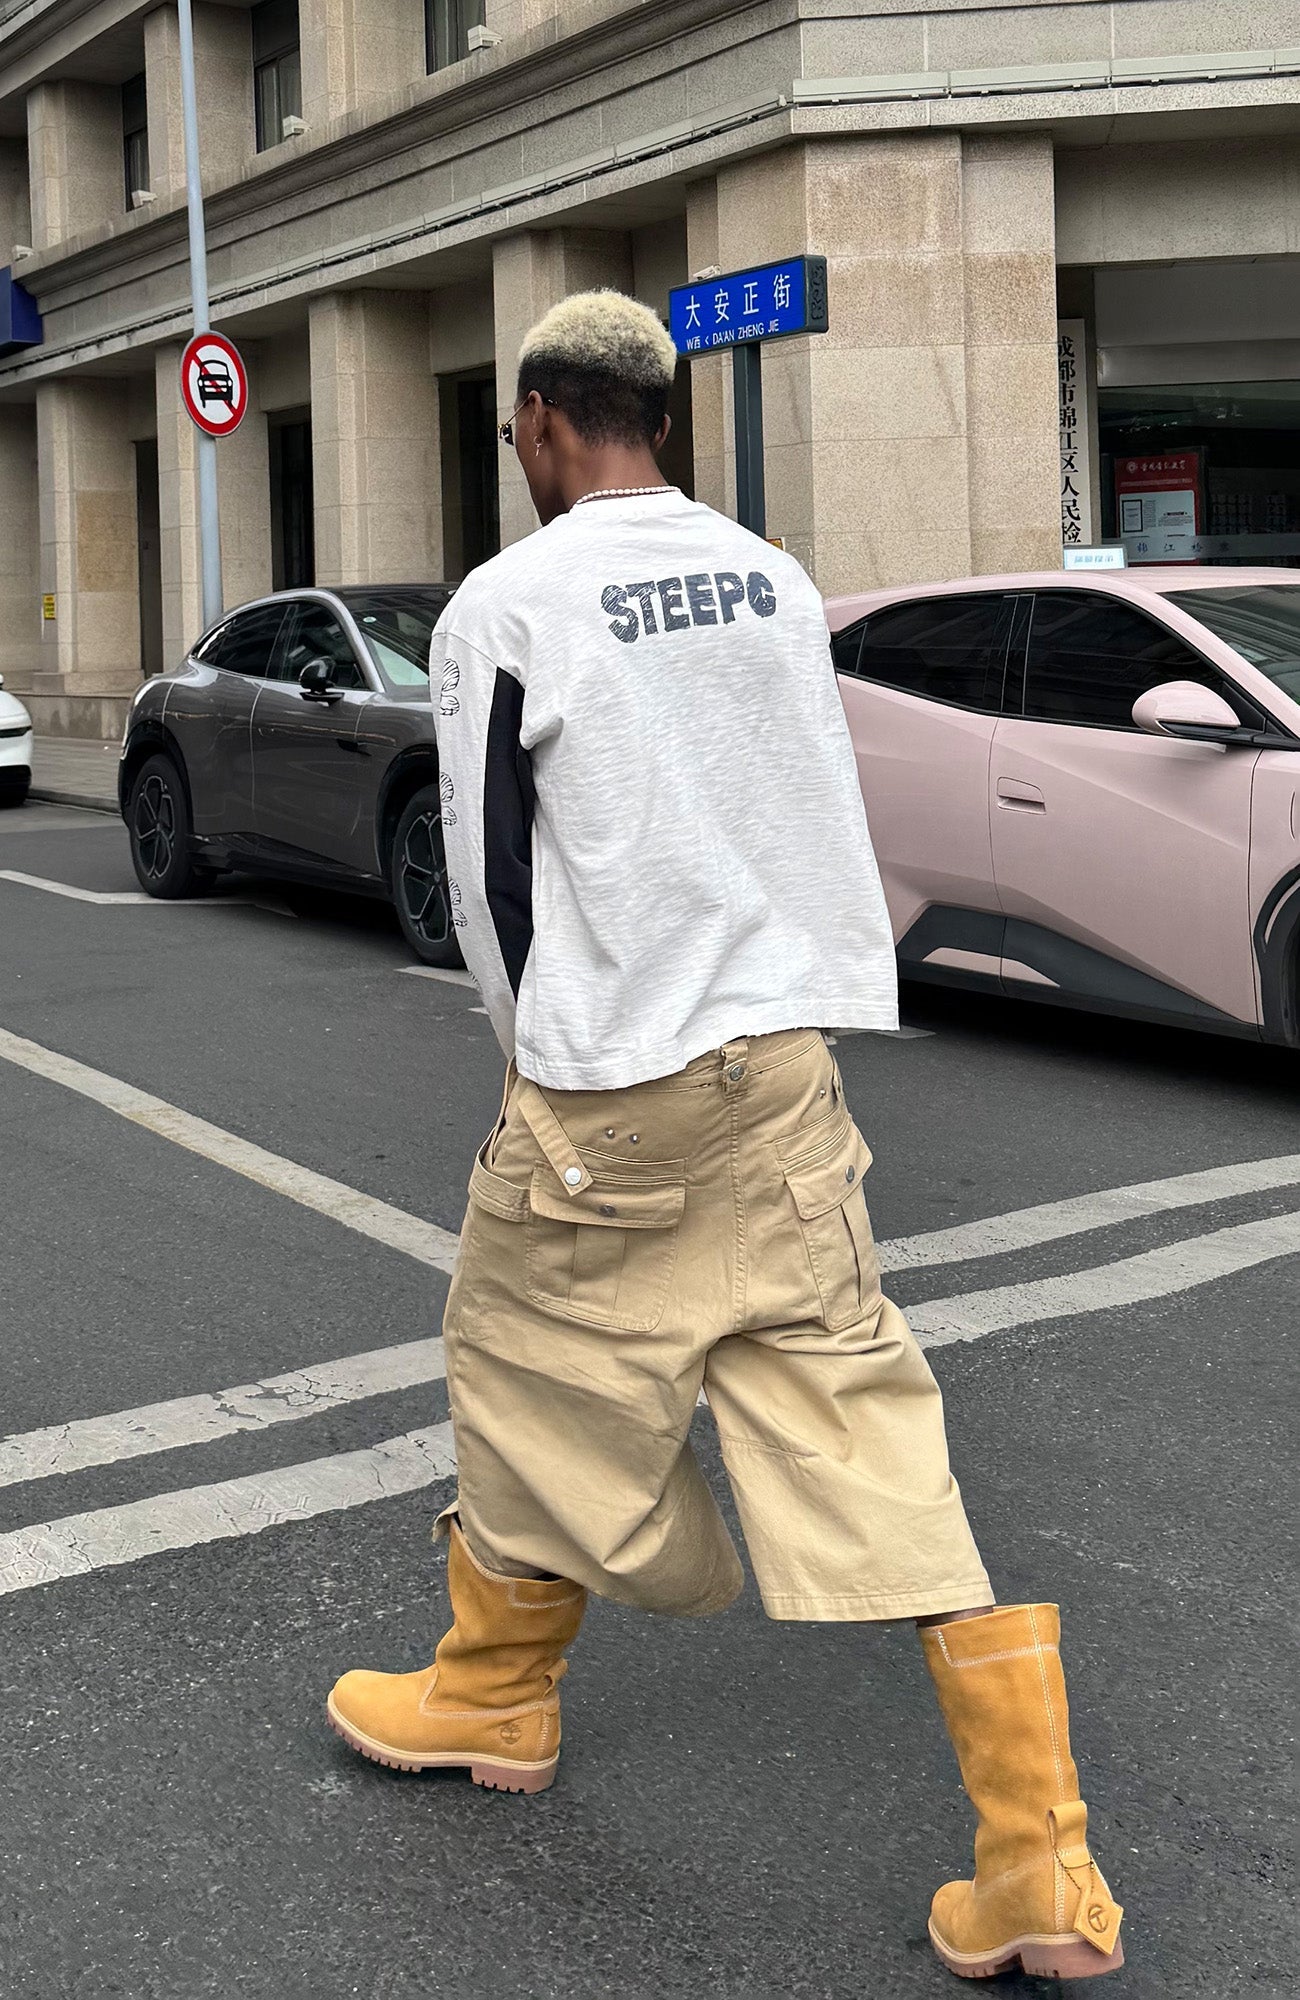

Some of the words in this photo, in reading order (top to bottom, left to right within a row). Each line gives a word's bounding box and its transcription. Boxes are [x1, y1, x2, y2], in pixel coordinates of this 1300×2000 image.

[685, 273, 791, 330] 大安正街
[737, 322, 765, 340] ZHENG
[768, 318, 780, 333] JIE
